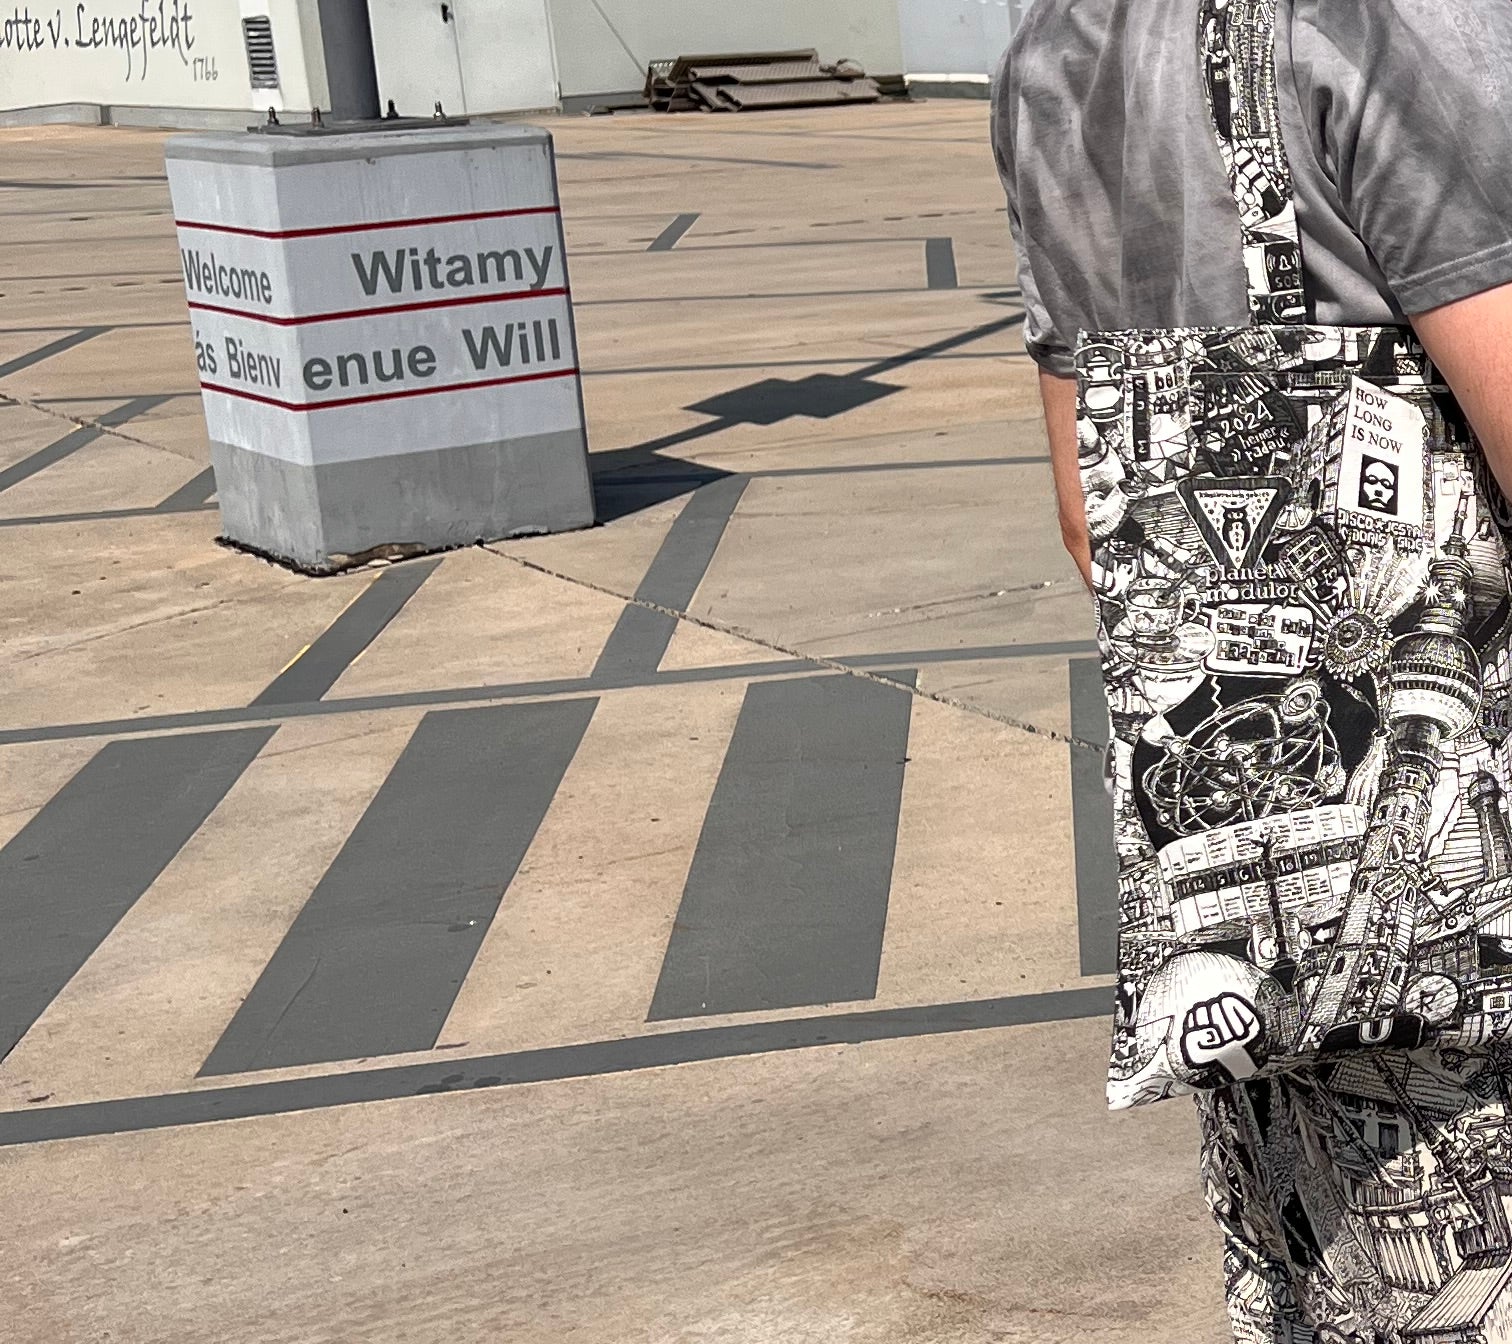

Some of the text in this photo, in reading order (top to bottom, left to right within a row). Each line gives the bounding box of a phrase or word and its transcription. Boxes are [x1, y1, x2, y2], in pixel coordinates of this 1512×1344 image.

[0, 6, 44, 52] otte
[47, 8, 69, 49] v.
[192, 55, 219, 82] 1766
[181, 247, 273, 305] Welcome
[350, 244, 554, 297] Witamy
[224, 335, 281, 389] Bienv
[302, 317, 561, 391] enue Will
[1356, 387, 1389, 410] HOW
[1219, 399, 1274, 438] 2024
[1353, 405, 1393, 432] LONG
[1351, 424, 1403, 454] IS NOW
[1205, 563, 1274, 587] planet
